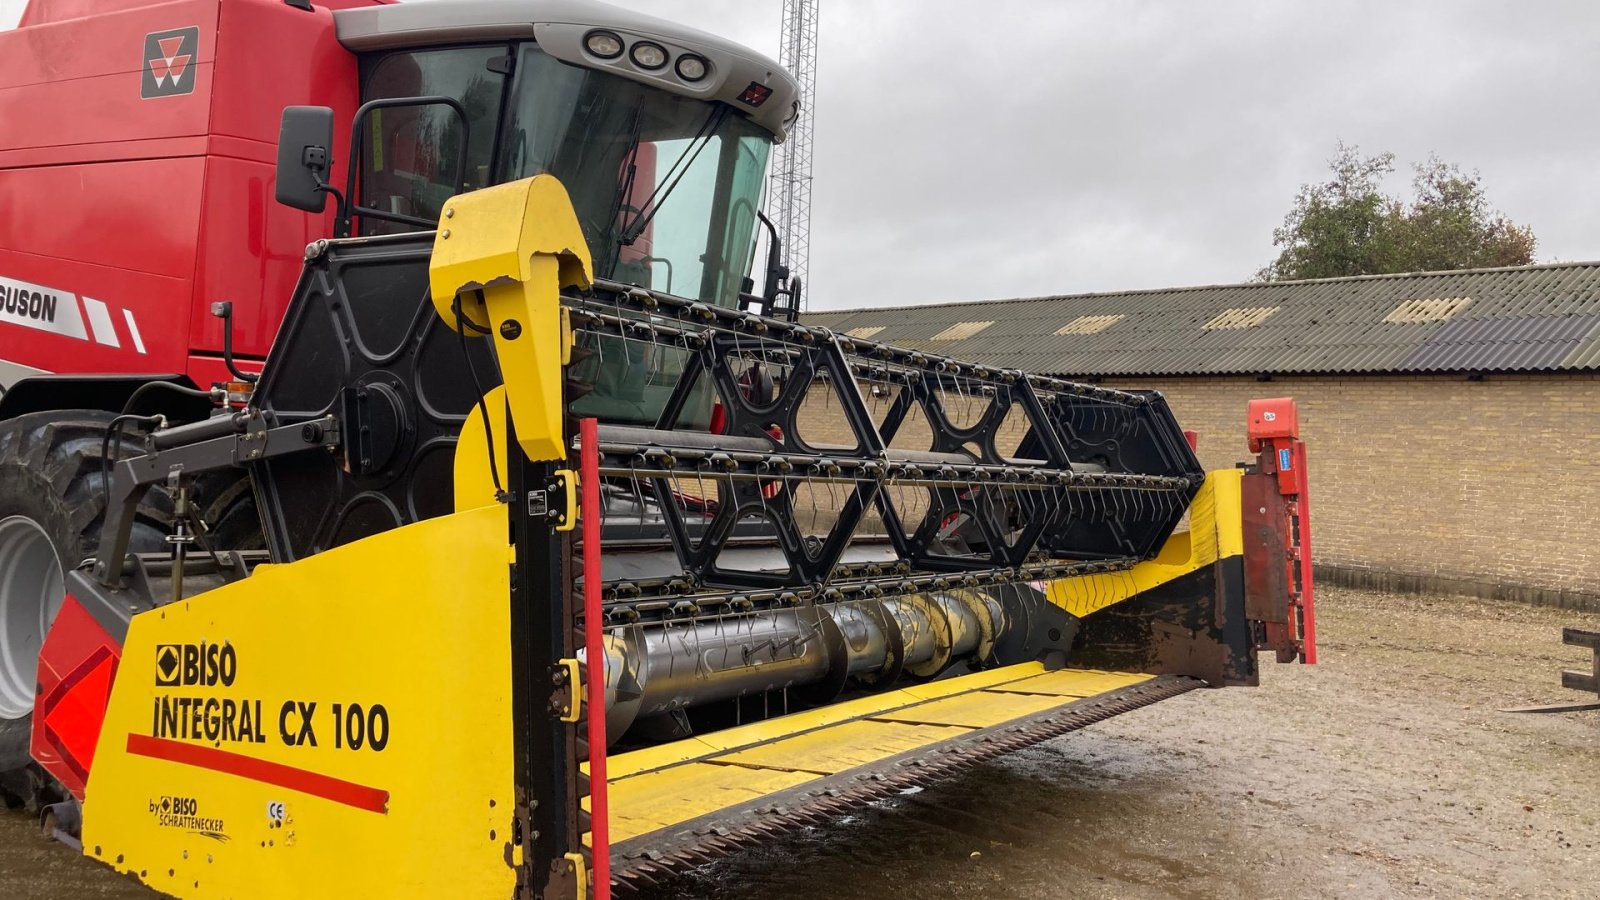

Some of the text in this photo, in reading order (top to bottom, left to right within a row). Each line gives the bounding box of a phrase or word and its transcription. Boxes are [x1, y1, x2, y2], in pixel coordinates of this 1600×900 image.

[183, 643, 237, 687] BISO
[152, 696, 389, 752] INTEGRAL CX 100
[149, 797, 197, 816] by BISO
[269, 802, 283, 819] CE
[159, 814, 224, 832] SCHRATTENECKER
